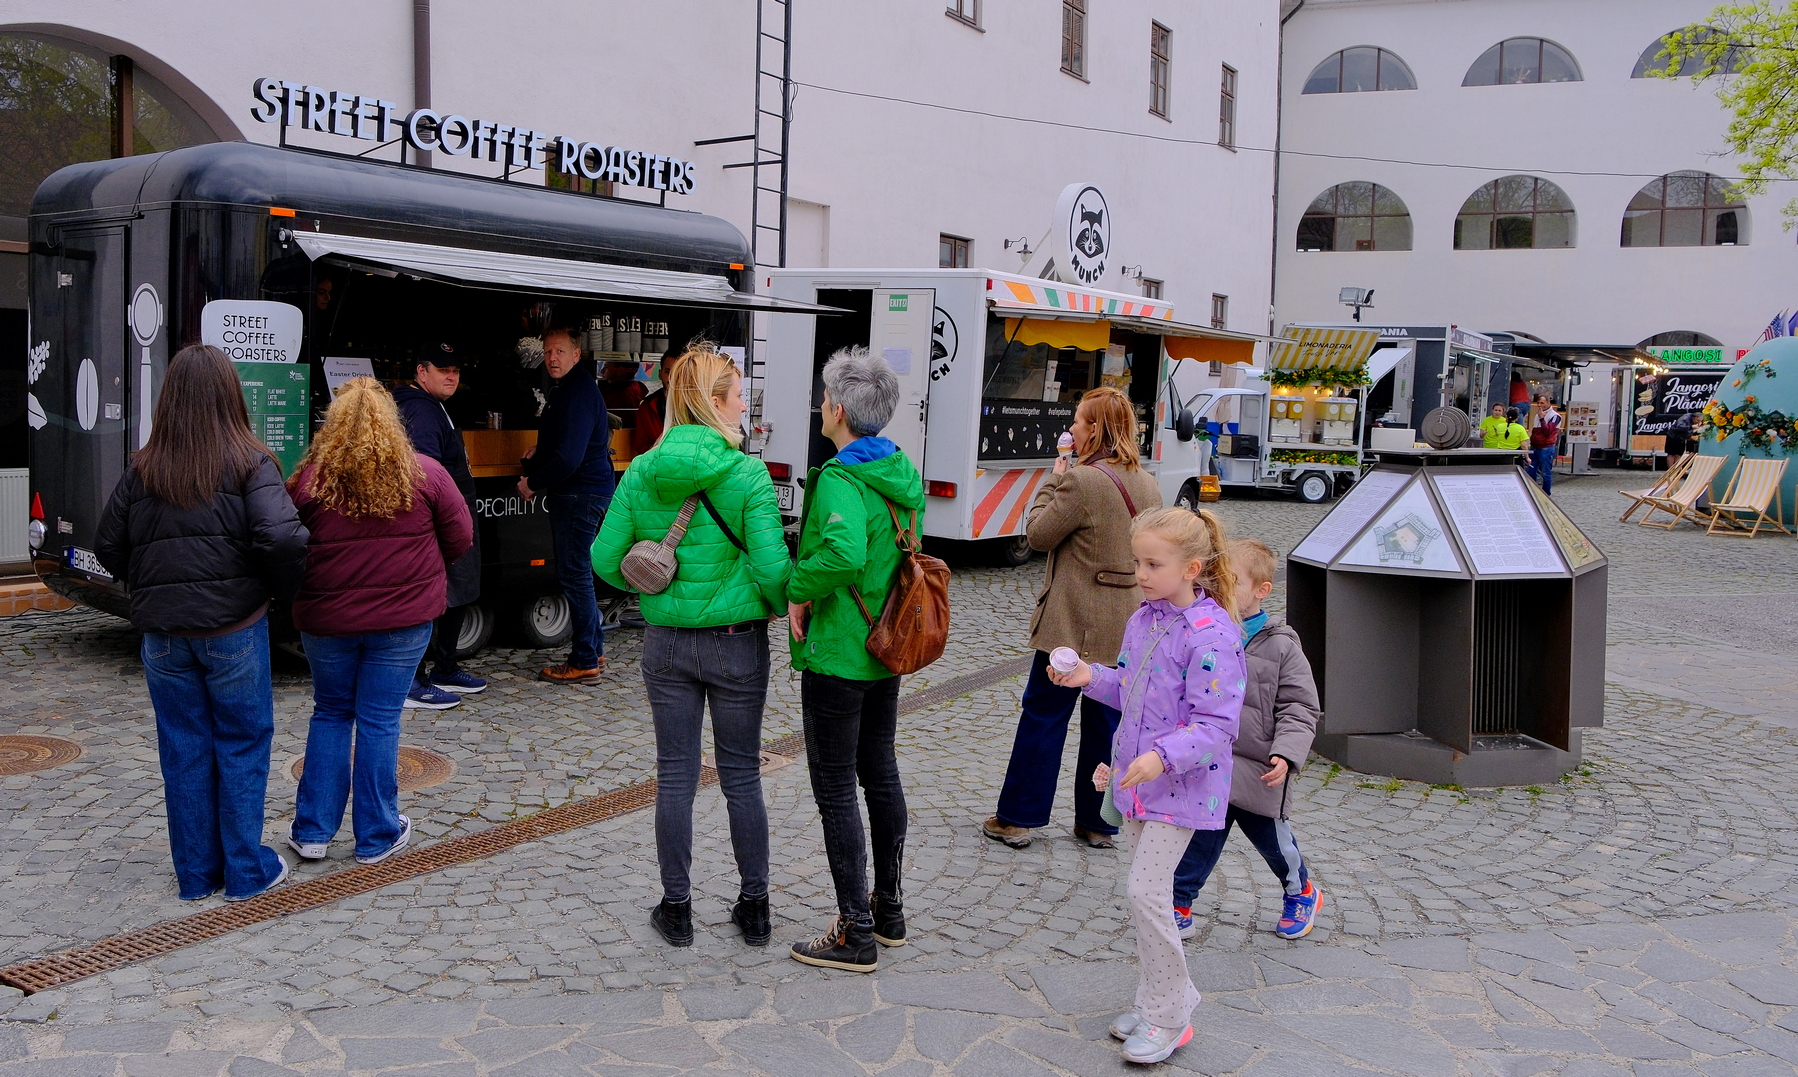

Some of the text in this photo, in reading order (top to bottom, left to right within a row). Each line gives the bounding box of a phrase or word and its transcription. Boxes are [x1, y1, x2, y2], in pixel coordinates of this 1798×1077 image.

[250, 77, 698, 196] STREET COFFEE ROASTERS
[1071, 254, 1105, 284] MUNCH
[890, 299, 902, 307] EXIT
[223, 315, 268, 329] STREET
[223, 331, 275, 345] COFFEE
[1380, 328, 1408, 336] ANIA
[1299, 342, 1352, 350] LIMONADERIA
[223, 347, 287, 362] ROASTERS
[1736, 349, 1751, 361] P
[782, 488, 790, 497] 13
[75, 551, 85, 569] BH
